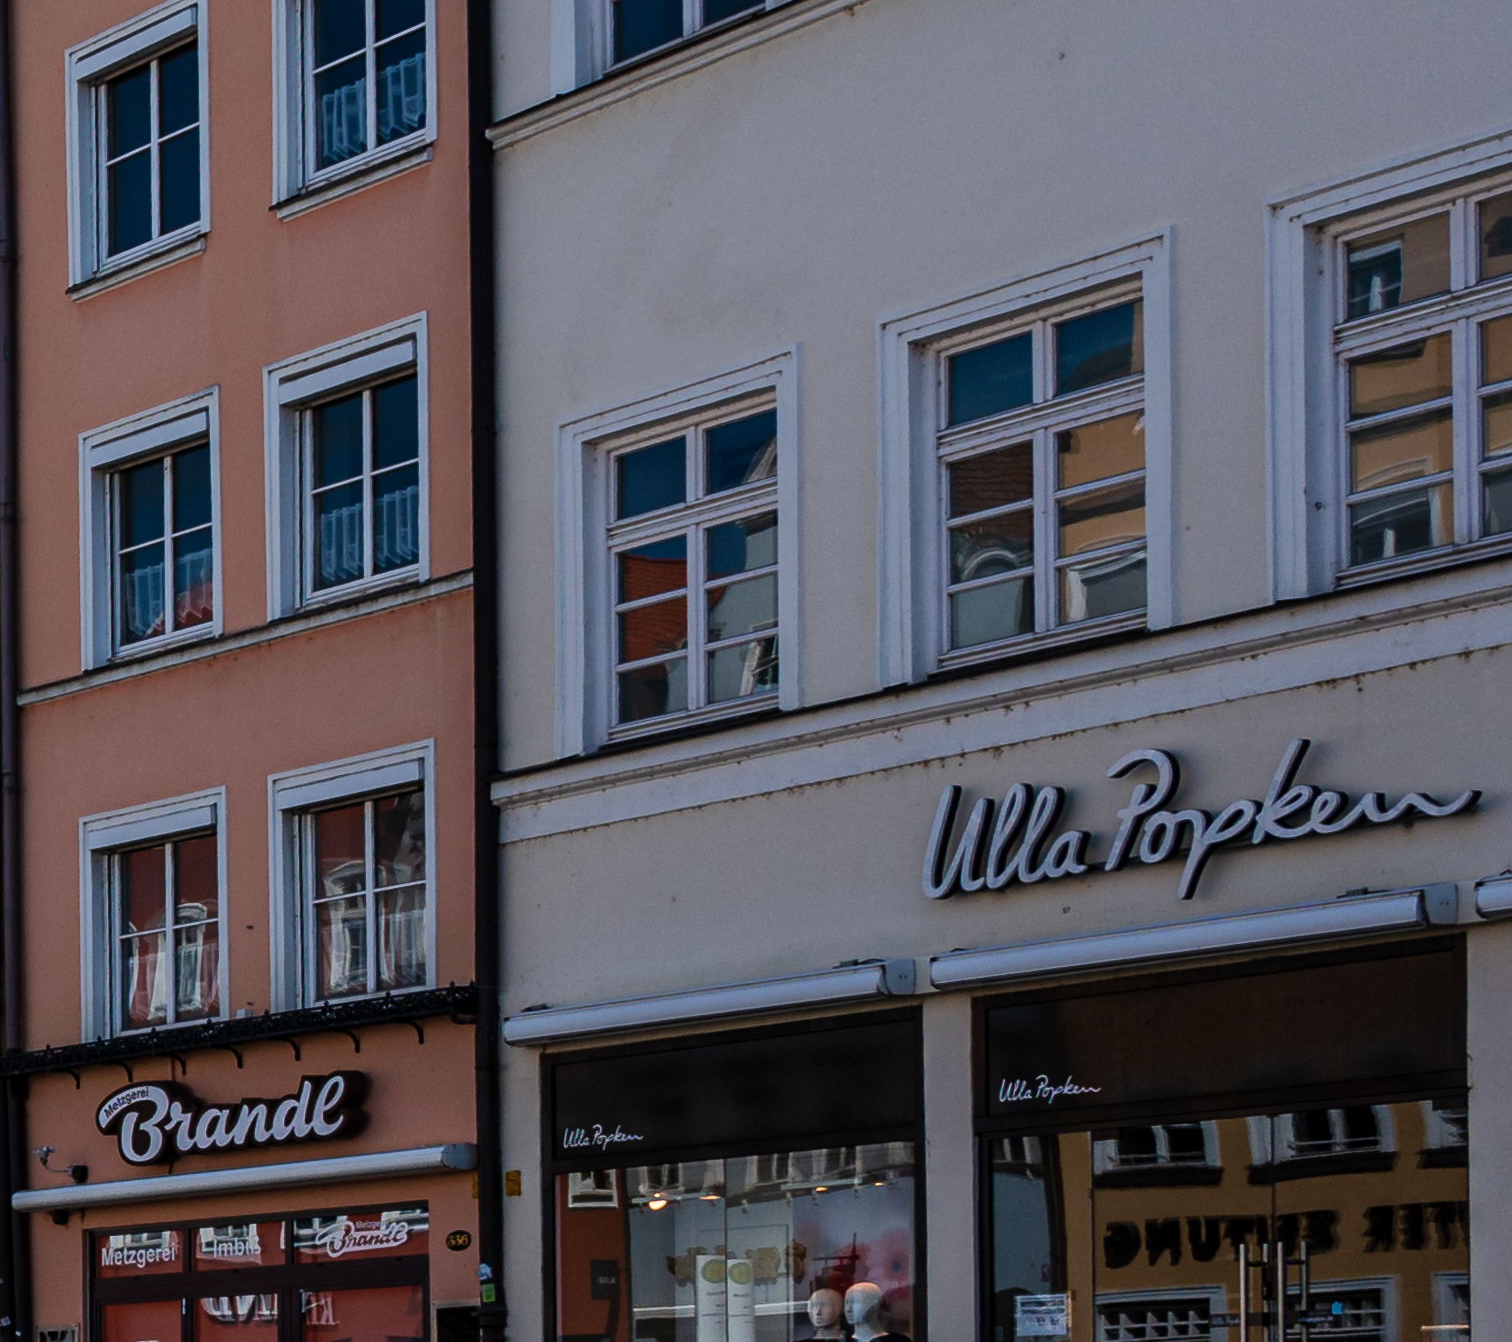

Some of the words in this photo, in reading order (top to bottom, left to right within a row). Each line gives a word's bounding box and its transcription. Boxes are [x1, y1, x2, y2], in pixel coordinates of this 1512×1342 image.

[922, 781, 1092, 900] Ulla
[1106, 737, 1482, 901] Popken
[103, 1086, 149, 1118] Metzgerei
[999, 1078, 1033, 1102] Ulla
[1035, 1074, 1101, 1104] Popken
[99, 1075, 345, 1162] Brandl
[563, 1127, 590, 1148] Ulla
[592, 1124, 644, 1151] Popken
[101, 1242, 176, 1269] Metzgerei
